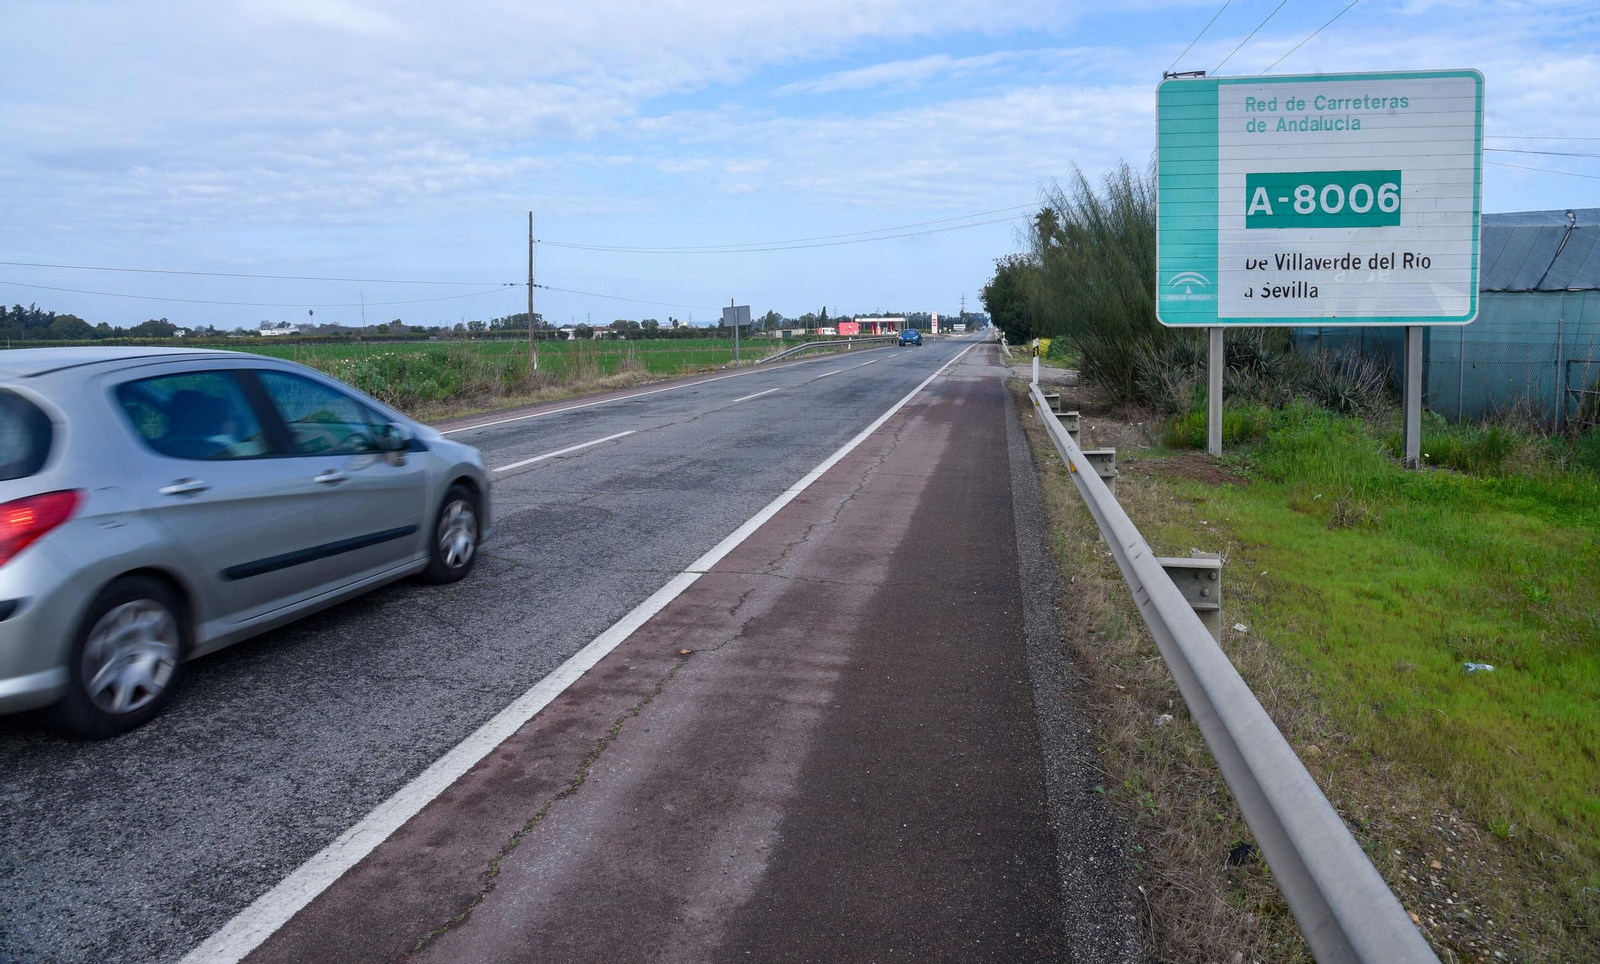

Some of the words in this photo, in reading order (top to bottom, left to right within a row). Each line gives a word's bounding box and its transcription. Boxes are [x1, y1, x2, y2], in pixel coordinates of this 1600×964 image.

[1246, 97, 1277, 112] Red
[1286, 96, 1305, 111] de
[1314, 94, 1409, 110] Carreteras
[1246, 117, 1266, 133] de
[1276, 115, 1361, 132] Andalucía
[1247, 182, 1400, 214] A-8006
[1275, 253, 1361, 271] Villaverde
[1368, 252, 1395, 270] del
[1402, 252, 1431, 270] Río
[1261, 281, 1319, 299] Sevilla
